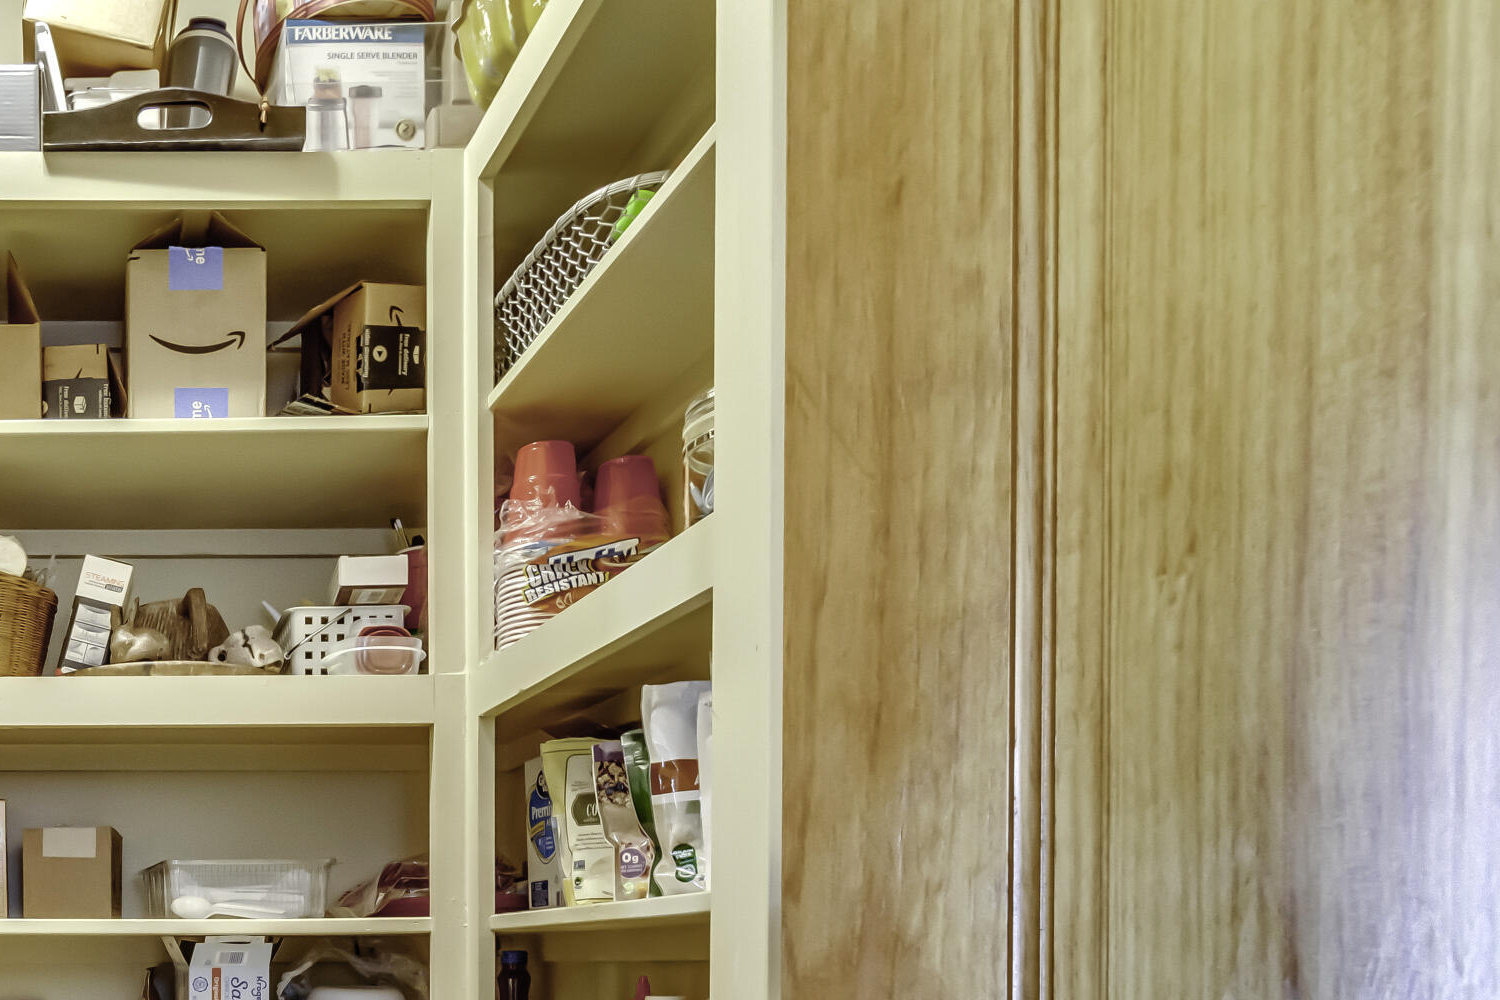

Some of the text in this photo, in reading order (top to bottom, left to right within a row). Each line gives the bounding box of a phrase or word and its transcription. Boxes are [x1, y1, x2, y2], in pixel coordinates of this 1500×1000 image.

[294, 26, 393, 41] FARBERWARE
[327, 52, 418, 60] SINGLE SERVE BLENDER
[525, 571, 607, 603] RESISTANT
